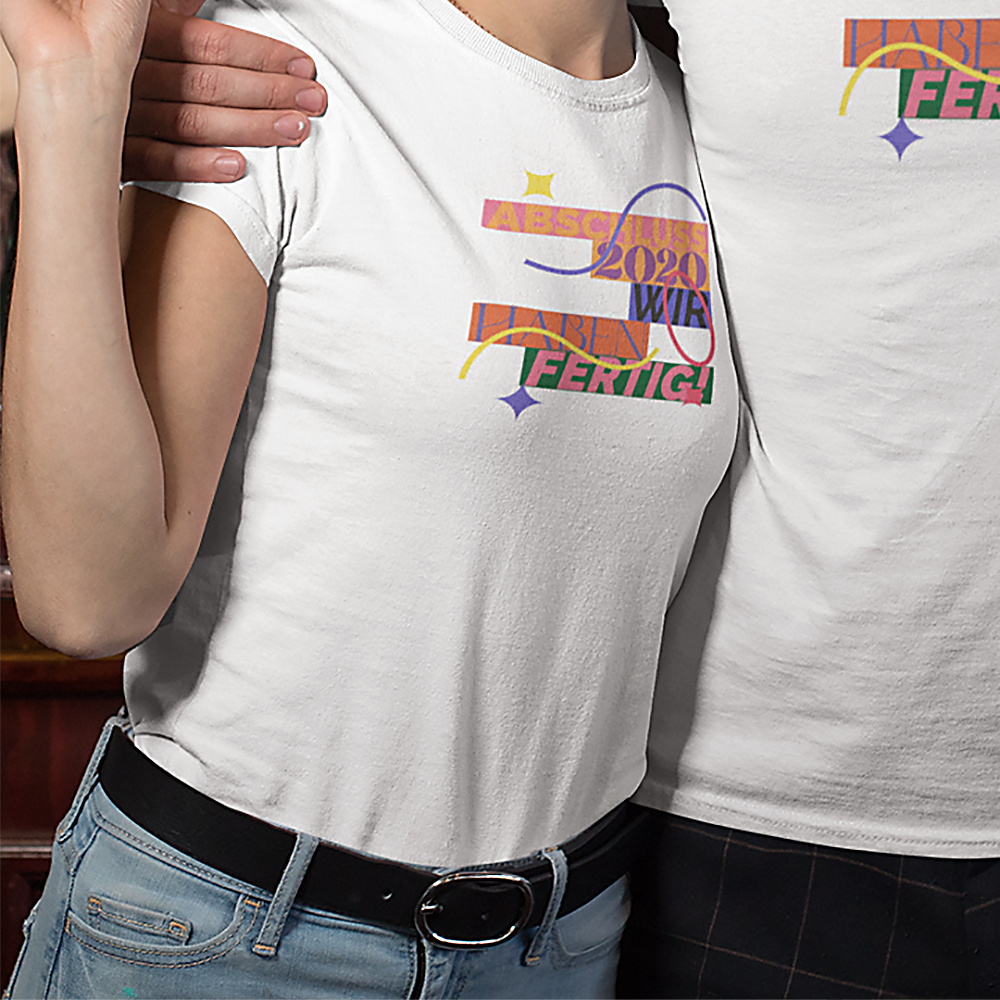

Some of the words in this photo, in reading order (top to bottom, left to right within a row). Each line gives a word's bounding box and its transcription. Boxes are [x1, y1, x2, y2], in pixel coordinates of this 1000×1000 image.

[487, 201, 707, 252] ABSCHLUSS
[595, 242, 707, 289] 2020
[475, 303, 650, 360] HABEN
[633, 284, 708, 329] WIR
[525, 349, 710, 401] FERTIG!
